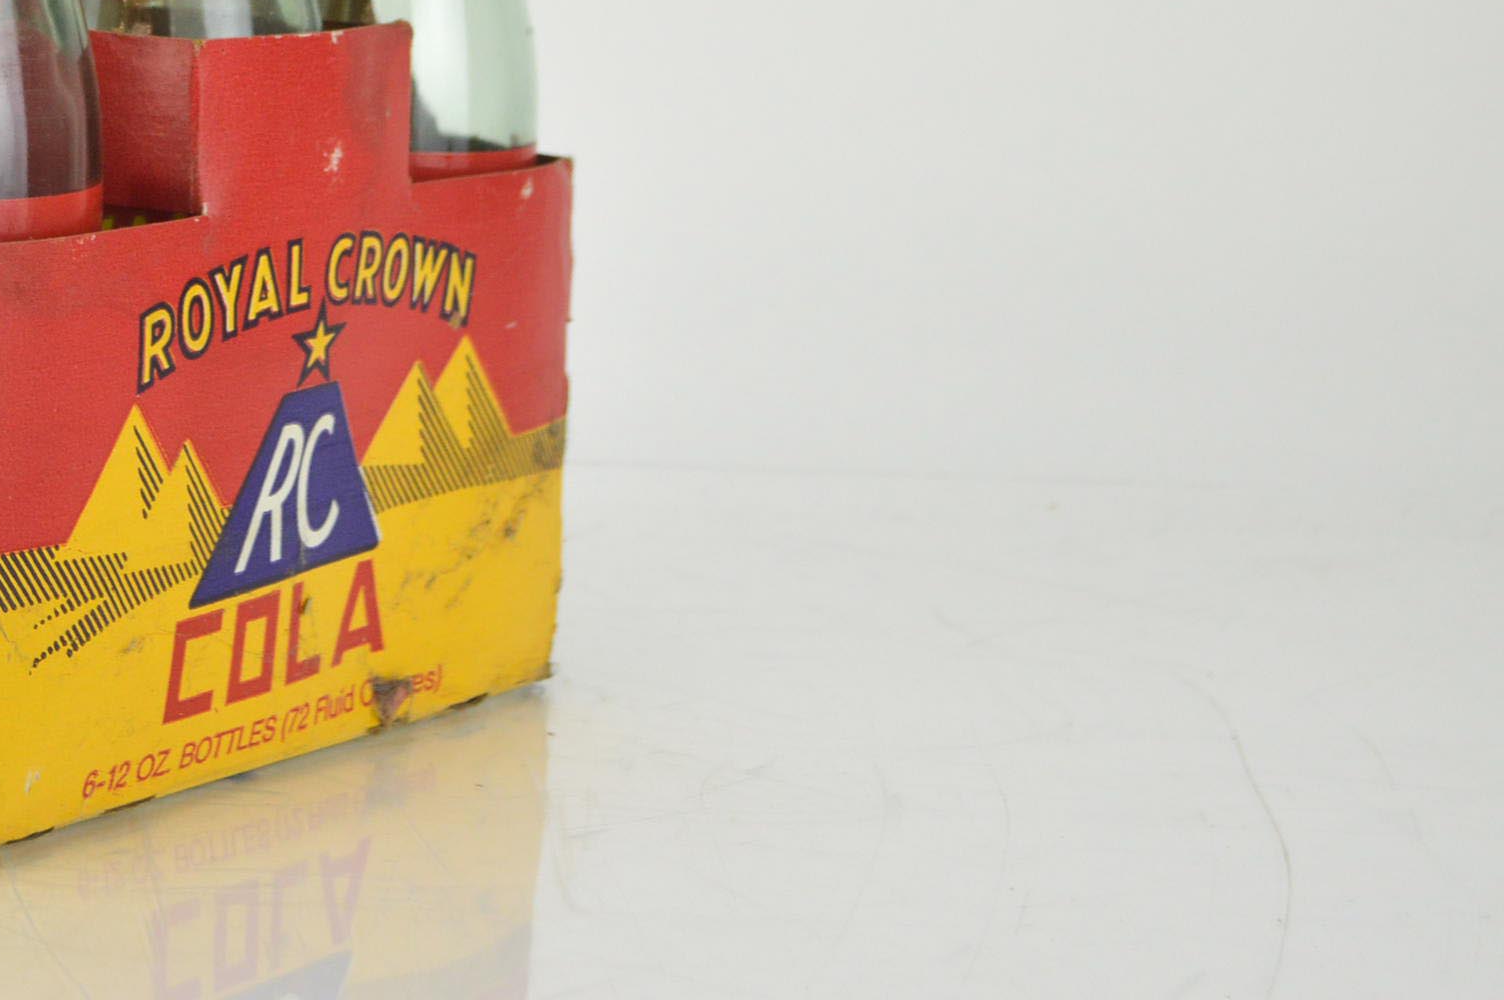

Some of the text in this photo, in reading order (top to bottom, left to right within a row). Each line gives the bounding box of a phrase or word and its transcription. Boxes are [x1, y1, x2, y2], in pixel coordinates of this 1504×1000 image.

[136, 230, 480, 393] ROYAL CROWN
[233, 413, 340, 573] RC
[161, 559, 385, 724] COLA
[81, 760, 131, 800] 6-12
[178, 714, 276, 771] BOTTLES
[280, 701, 310, 744] (72
[312, 683, 355, 725] Fluid
[358, 663, 444, 708] Oes)
